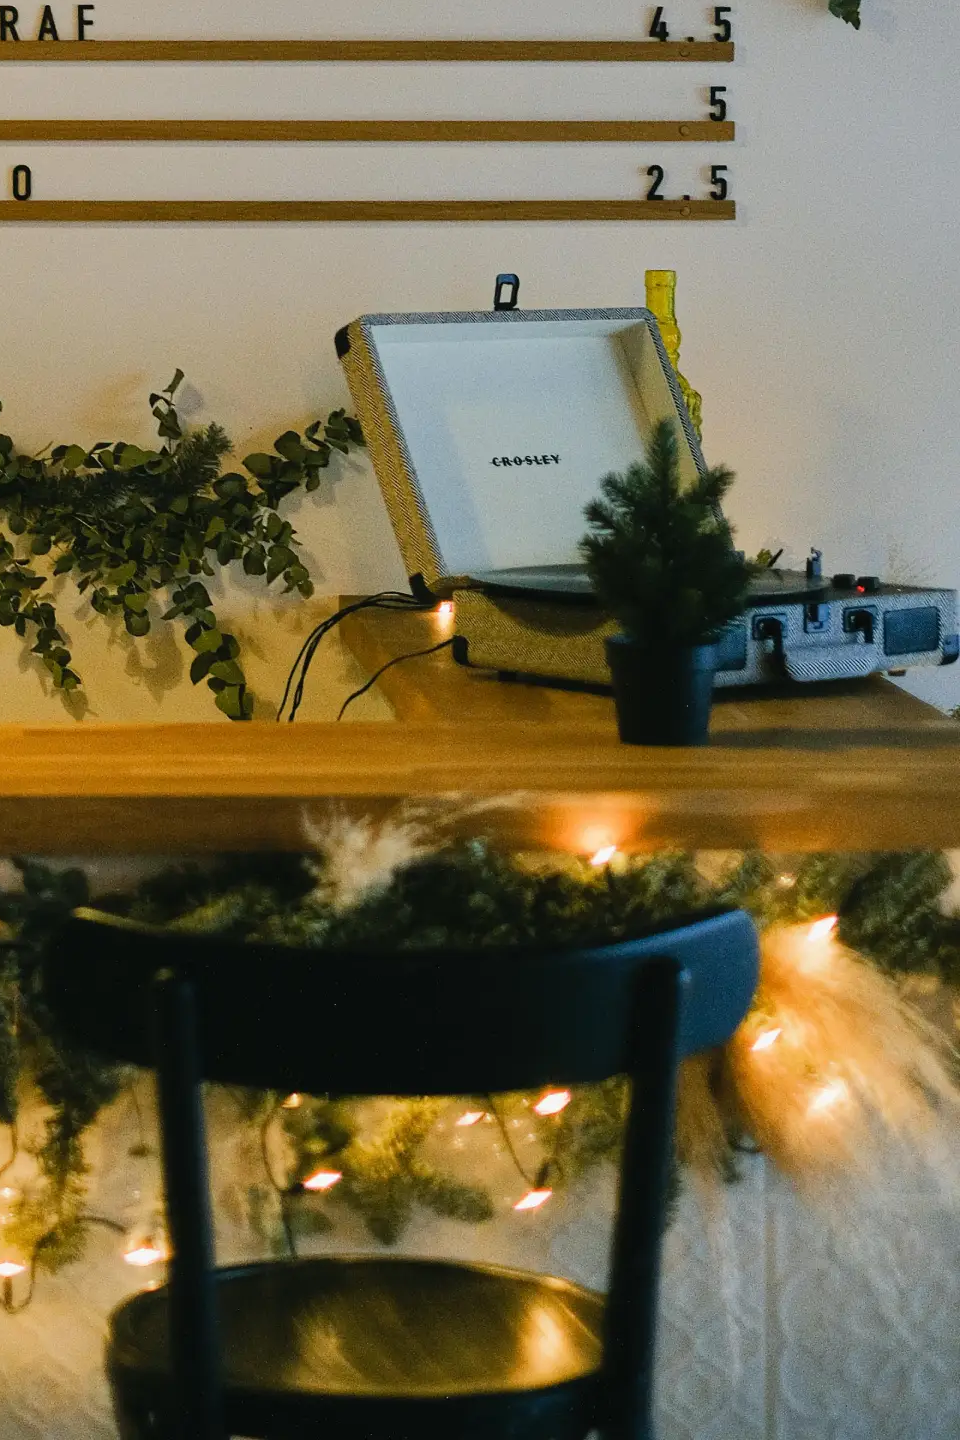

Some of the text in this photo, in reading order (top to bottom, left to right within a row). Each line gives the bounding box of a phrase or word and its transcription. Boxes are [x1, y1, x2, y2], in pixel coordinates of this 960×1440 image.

[0, 4, 96, 40] RAF
[649, 6, 732, 42] 4.5
[709, 86, 727, 122] 5
[646, 165, 728, 201] 2.5
[491, 454, 560, 467] CROSLEY
